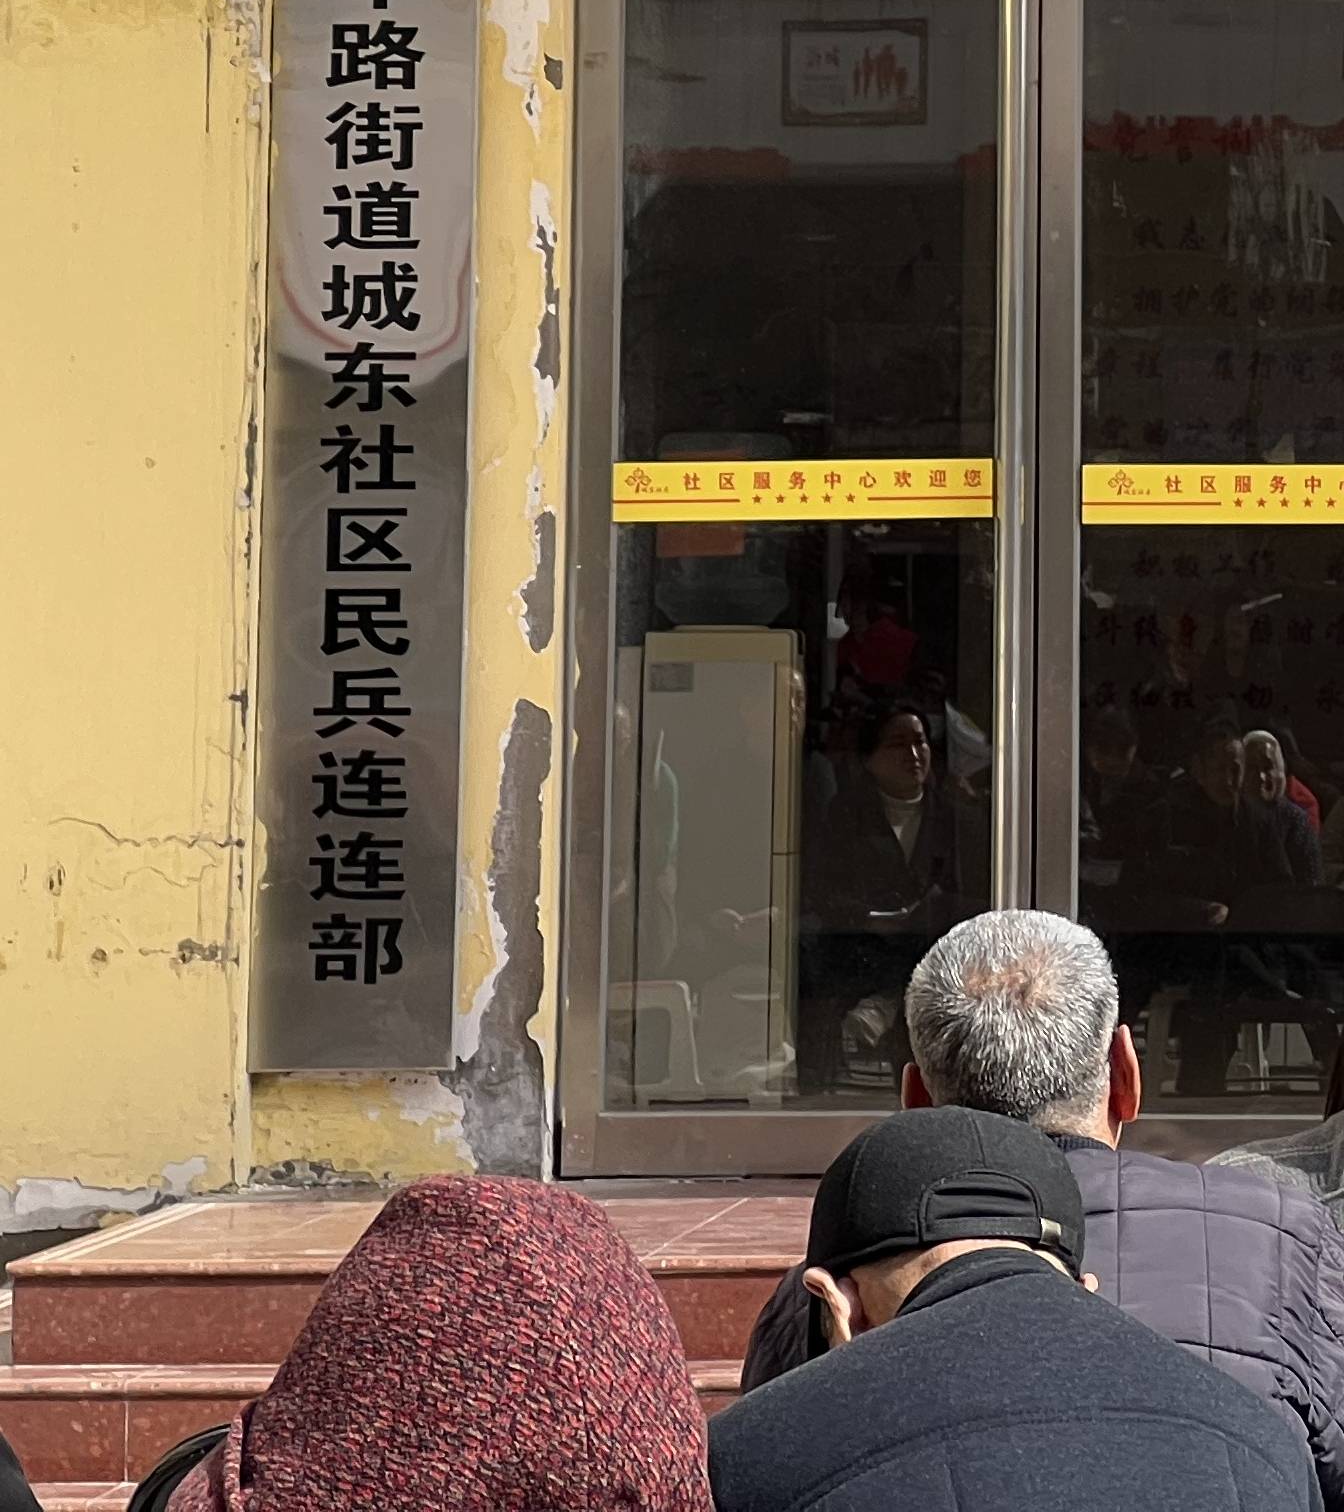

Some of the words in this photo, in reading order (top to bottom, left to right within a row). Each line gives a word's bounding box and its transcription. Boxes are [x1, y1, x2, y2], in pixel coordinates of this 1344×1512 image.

[683, 468, 984, 491] 社区服务中心欢迎您
